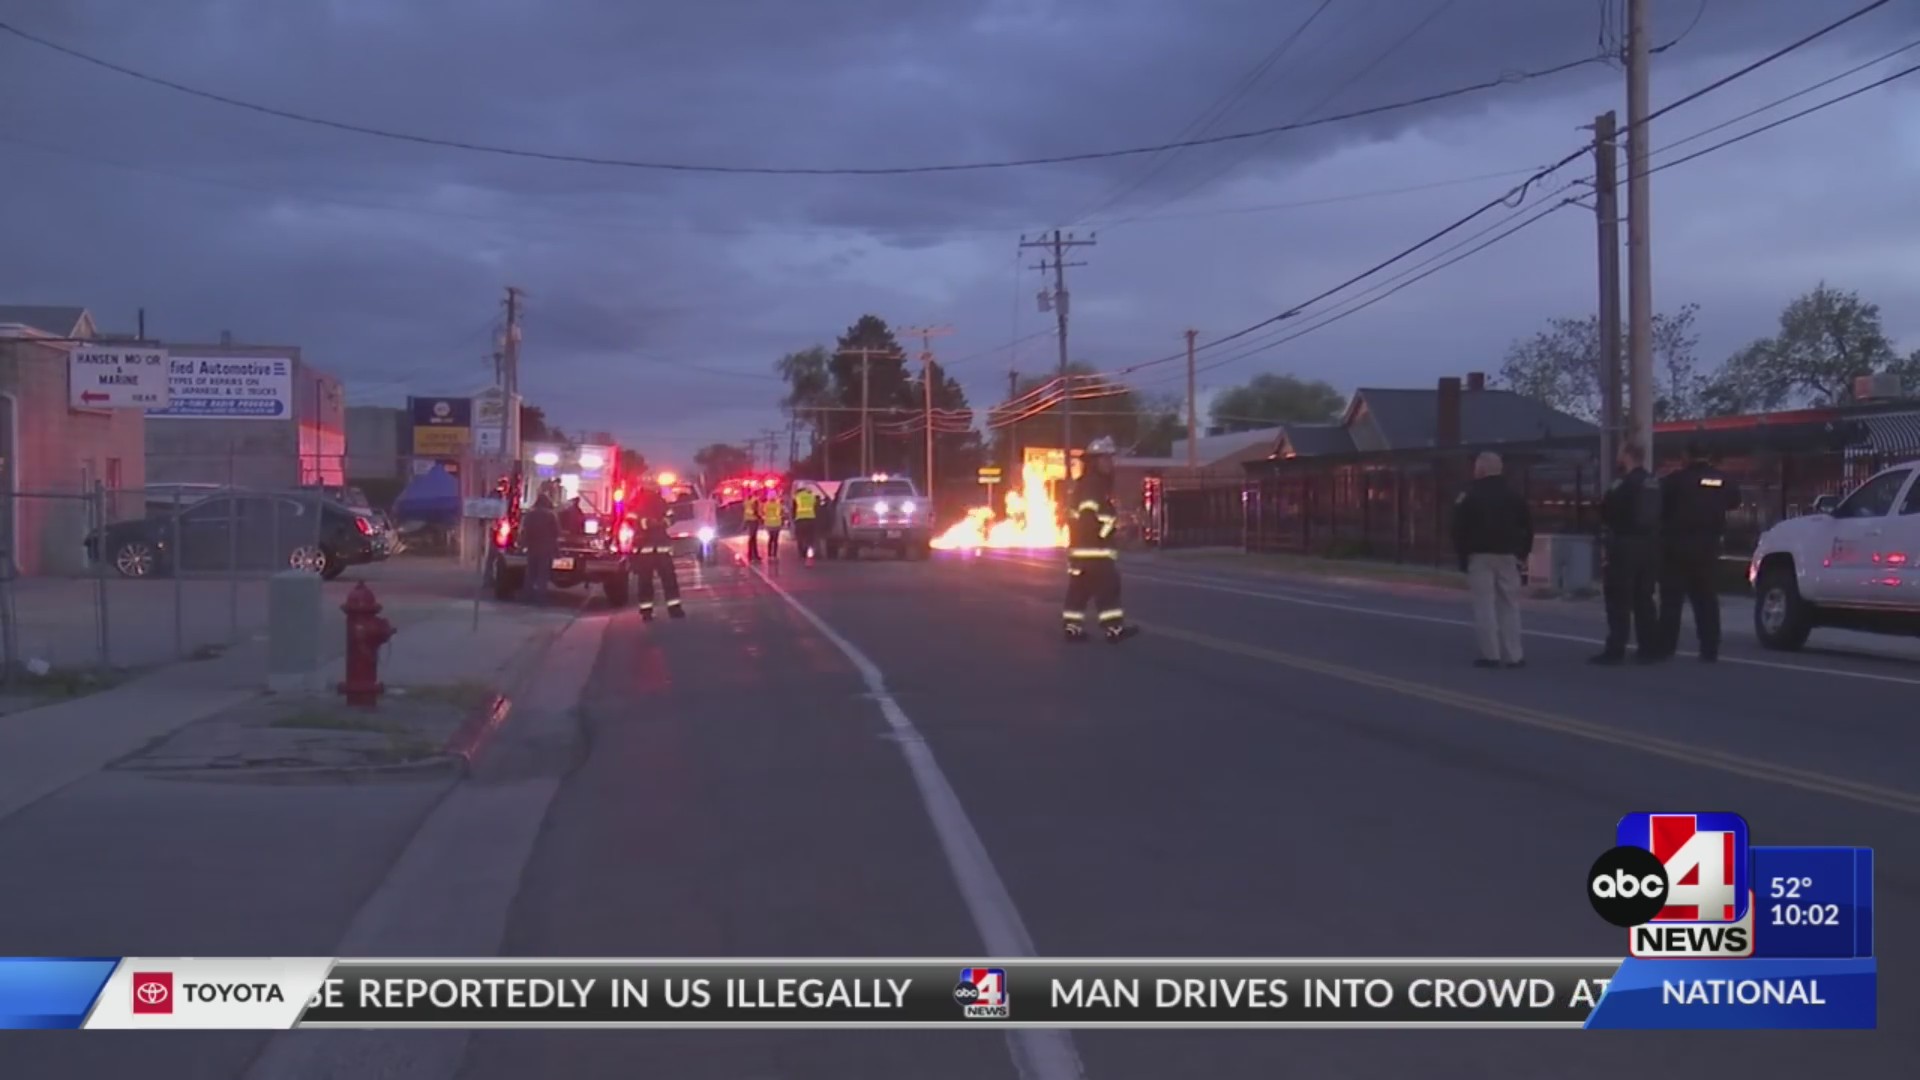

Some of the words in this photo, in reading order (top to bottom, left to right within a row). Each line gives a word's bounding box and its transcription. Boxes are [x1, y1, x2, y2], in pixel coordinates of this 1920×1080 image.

[77, 353, 119, 364] HANSEN
[200, 361, 271, 376] Automotive
[99, 375, 139, 386] MARINE
